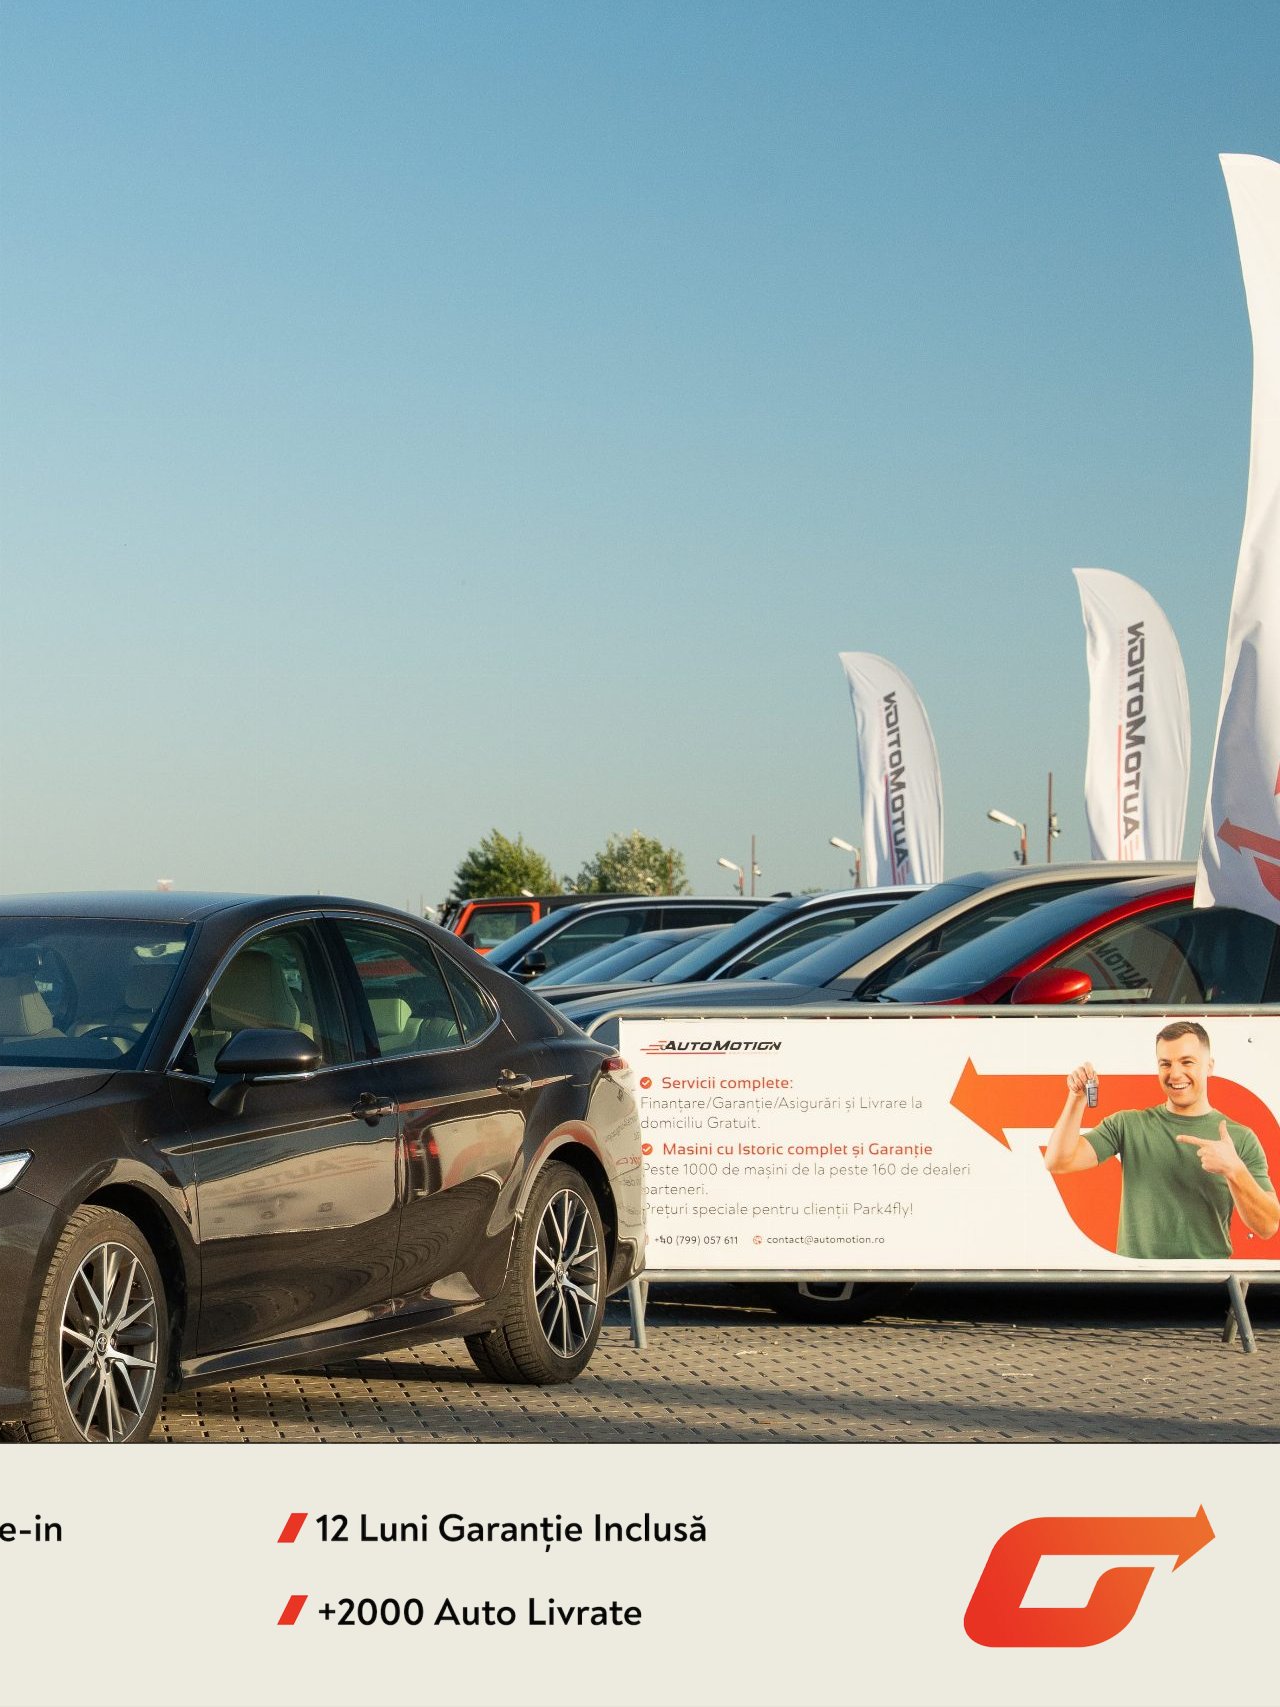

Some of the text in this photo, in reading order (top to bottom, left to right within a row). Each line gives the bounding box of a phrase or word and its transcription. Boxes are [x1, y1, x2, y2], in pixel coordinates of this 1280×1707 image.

[662, 1077, 792, 1091] Servicii complete:
[641, 1096, 922, 1113] Finanțare/Garanție/Asigurări și Livrare la
[640, 1116, 703, 1129] domiciliu
[707, 1116, 760, 1128] Gratuit.
[664, 1143, 932, 1158] Masini cu Istoric complet și Garanție
[683, 1163, 718, 1175] 1000
[721, 1162, 740, 1175] de
[745, 1164, 787, 1178] mașini
[792, 1162, 809, 1175] de
[814, 1163, 824, 1175] la
[830, 1164, 869, 1178] peste
[872, 1163, 896, 1175] 160
[900, 1163, 918, 1175] de
[923, 1163, 970, 1175] dealeri
[692, 1202, 748, 1218] speciale
[752, 1204, 798, 1218] pentru
[804, 1202, 848, 1219] clienții
[854, 1202, 912, 1218] Park4fly!
[676, 1235, 700, 1246] (799)
[704, 1236, 720, 1244] 057
[724, 1236, 737, 1244] 611
[767, 1236, 884, 1245] contact@automotion.ro
